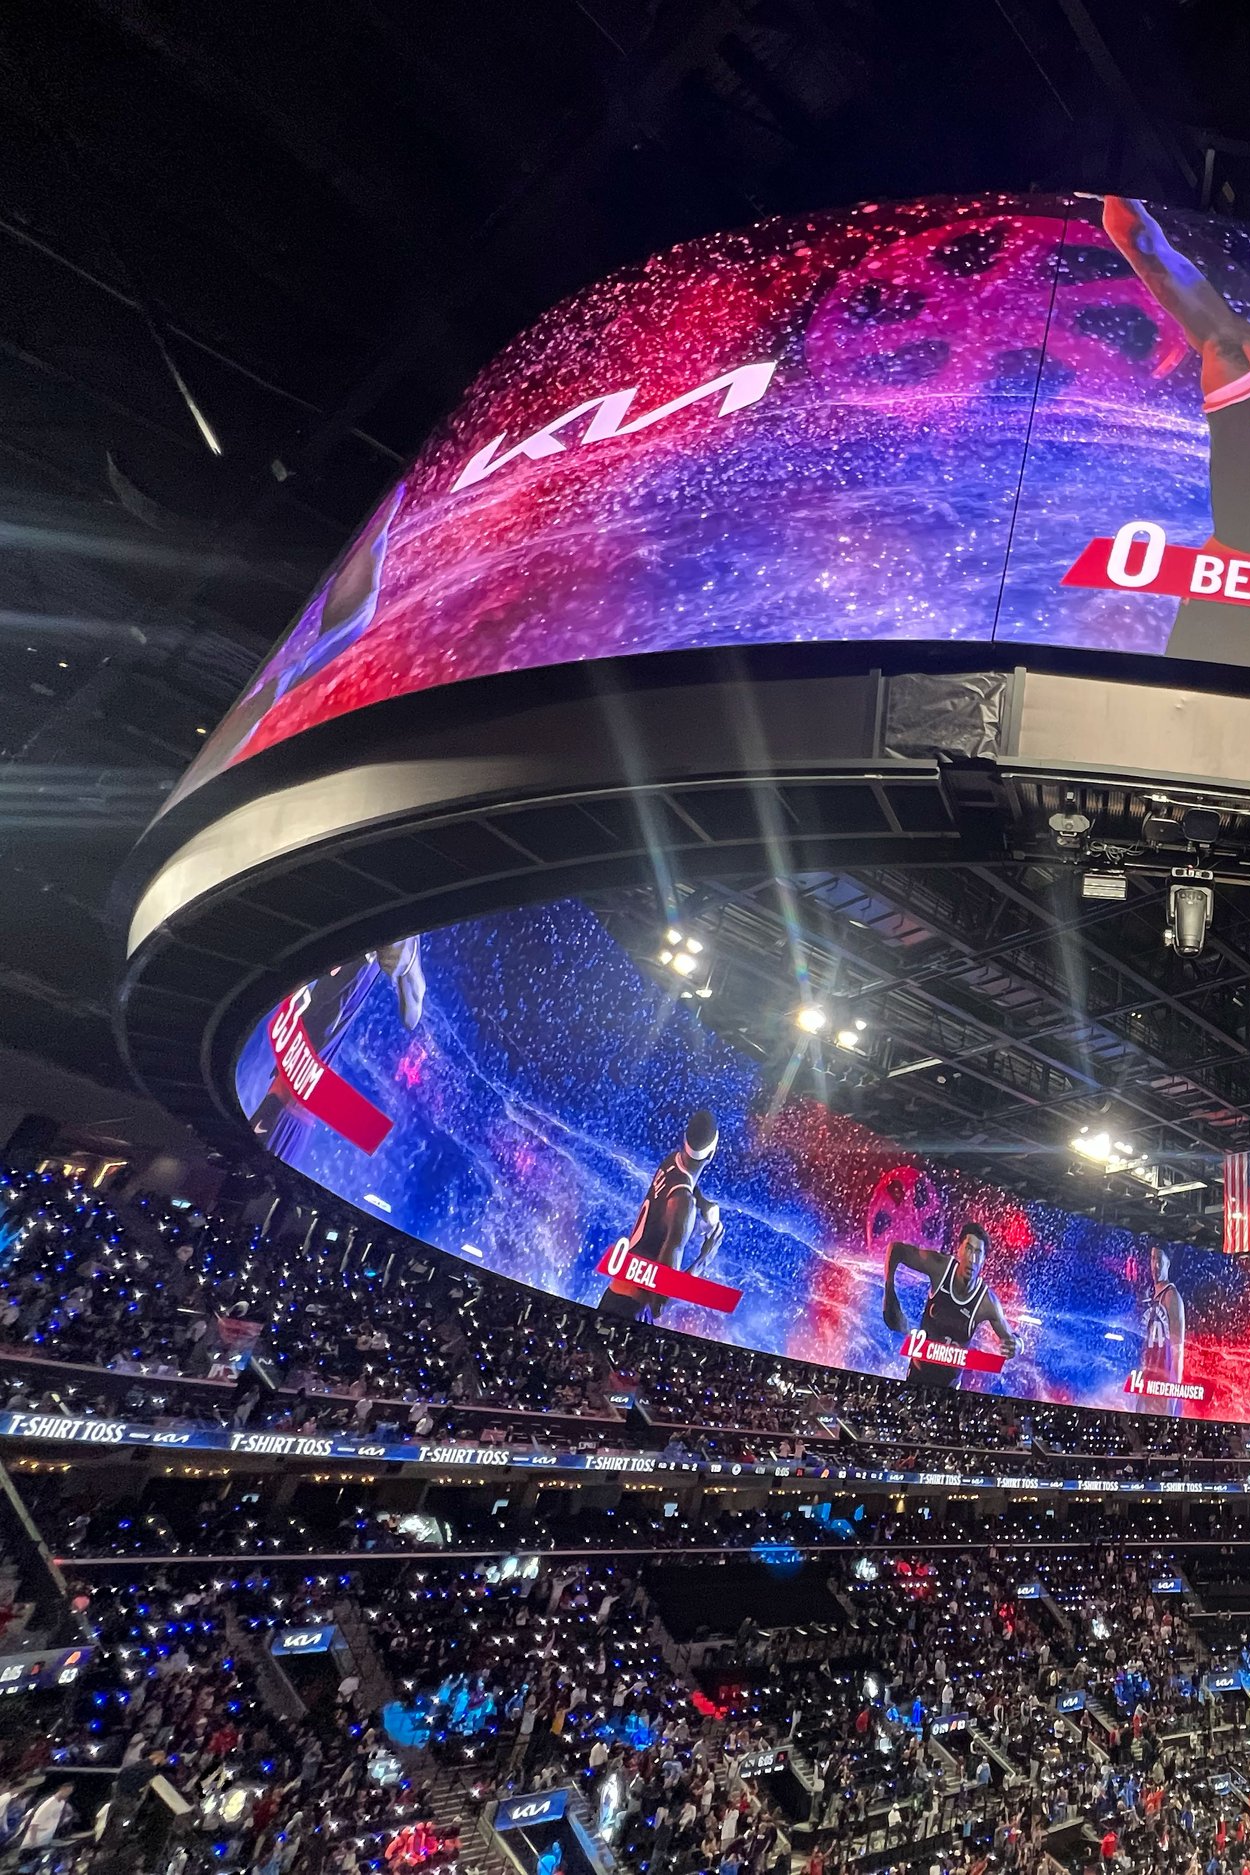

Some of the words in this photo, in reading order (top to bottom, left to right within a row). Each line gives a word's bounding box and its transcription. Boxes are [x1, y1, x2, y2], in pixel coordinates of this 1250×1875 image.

[1106, 520, 1167, 588] 0
[282, 1031, 324, 1101] BATUM
[607, 1237, 630, 1276] 0
[625, 1258, 659, 1289] BEAL
[907, 1329, 926, 1358] 12
[926, 1342, 968, 1366] CHRISTIE
[1130, 1369, 1144, 1393] 14
[1146, 1380, 1204, 1400] NIEDERHAUSER
[7, 1414, 85, 1440] T-SHIRT
[84, 1421, 127, 1443] TOSS
[230, 1433, 296, 1454] T-SHIRT
[295, 1438, 334, 1456] TOSS
[418, 1446, 473, 1464] T-SHIRT
[475, 1450, 509, 1465] TOSS
[585, 1455, 632, 1471] T-SHIRT
[919, 1473, 946, 1485] T-SHIRT
[945, 1474, 961, 1485] TOSS
[996, 1477, 1022, 1488] T-SHIRT
[1021, 1478, 1038, 1489] TOSS
